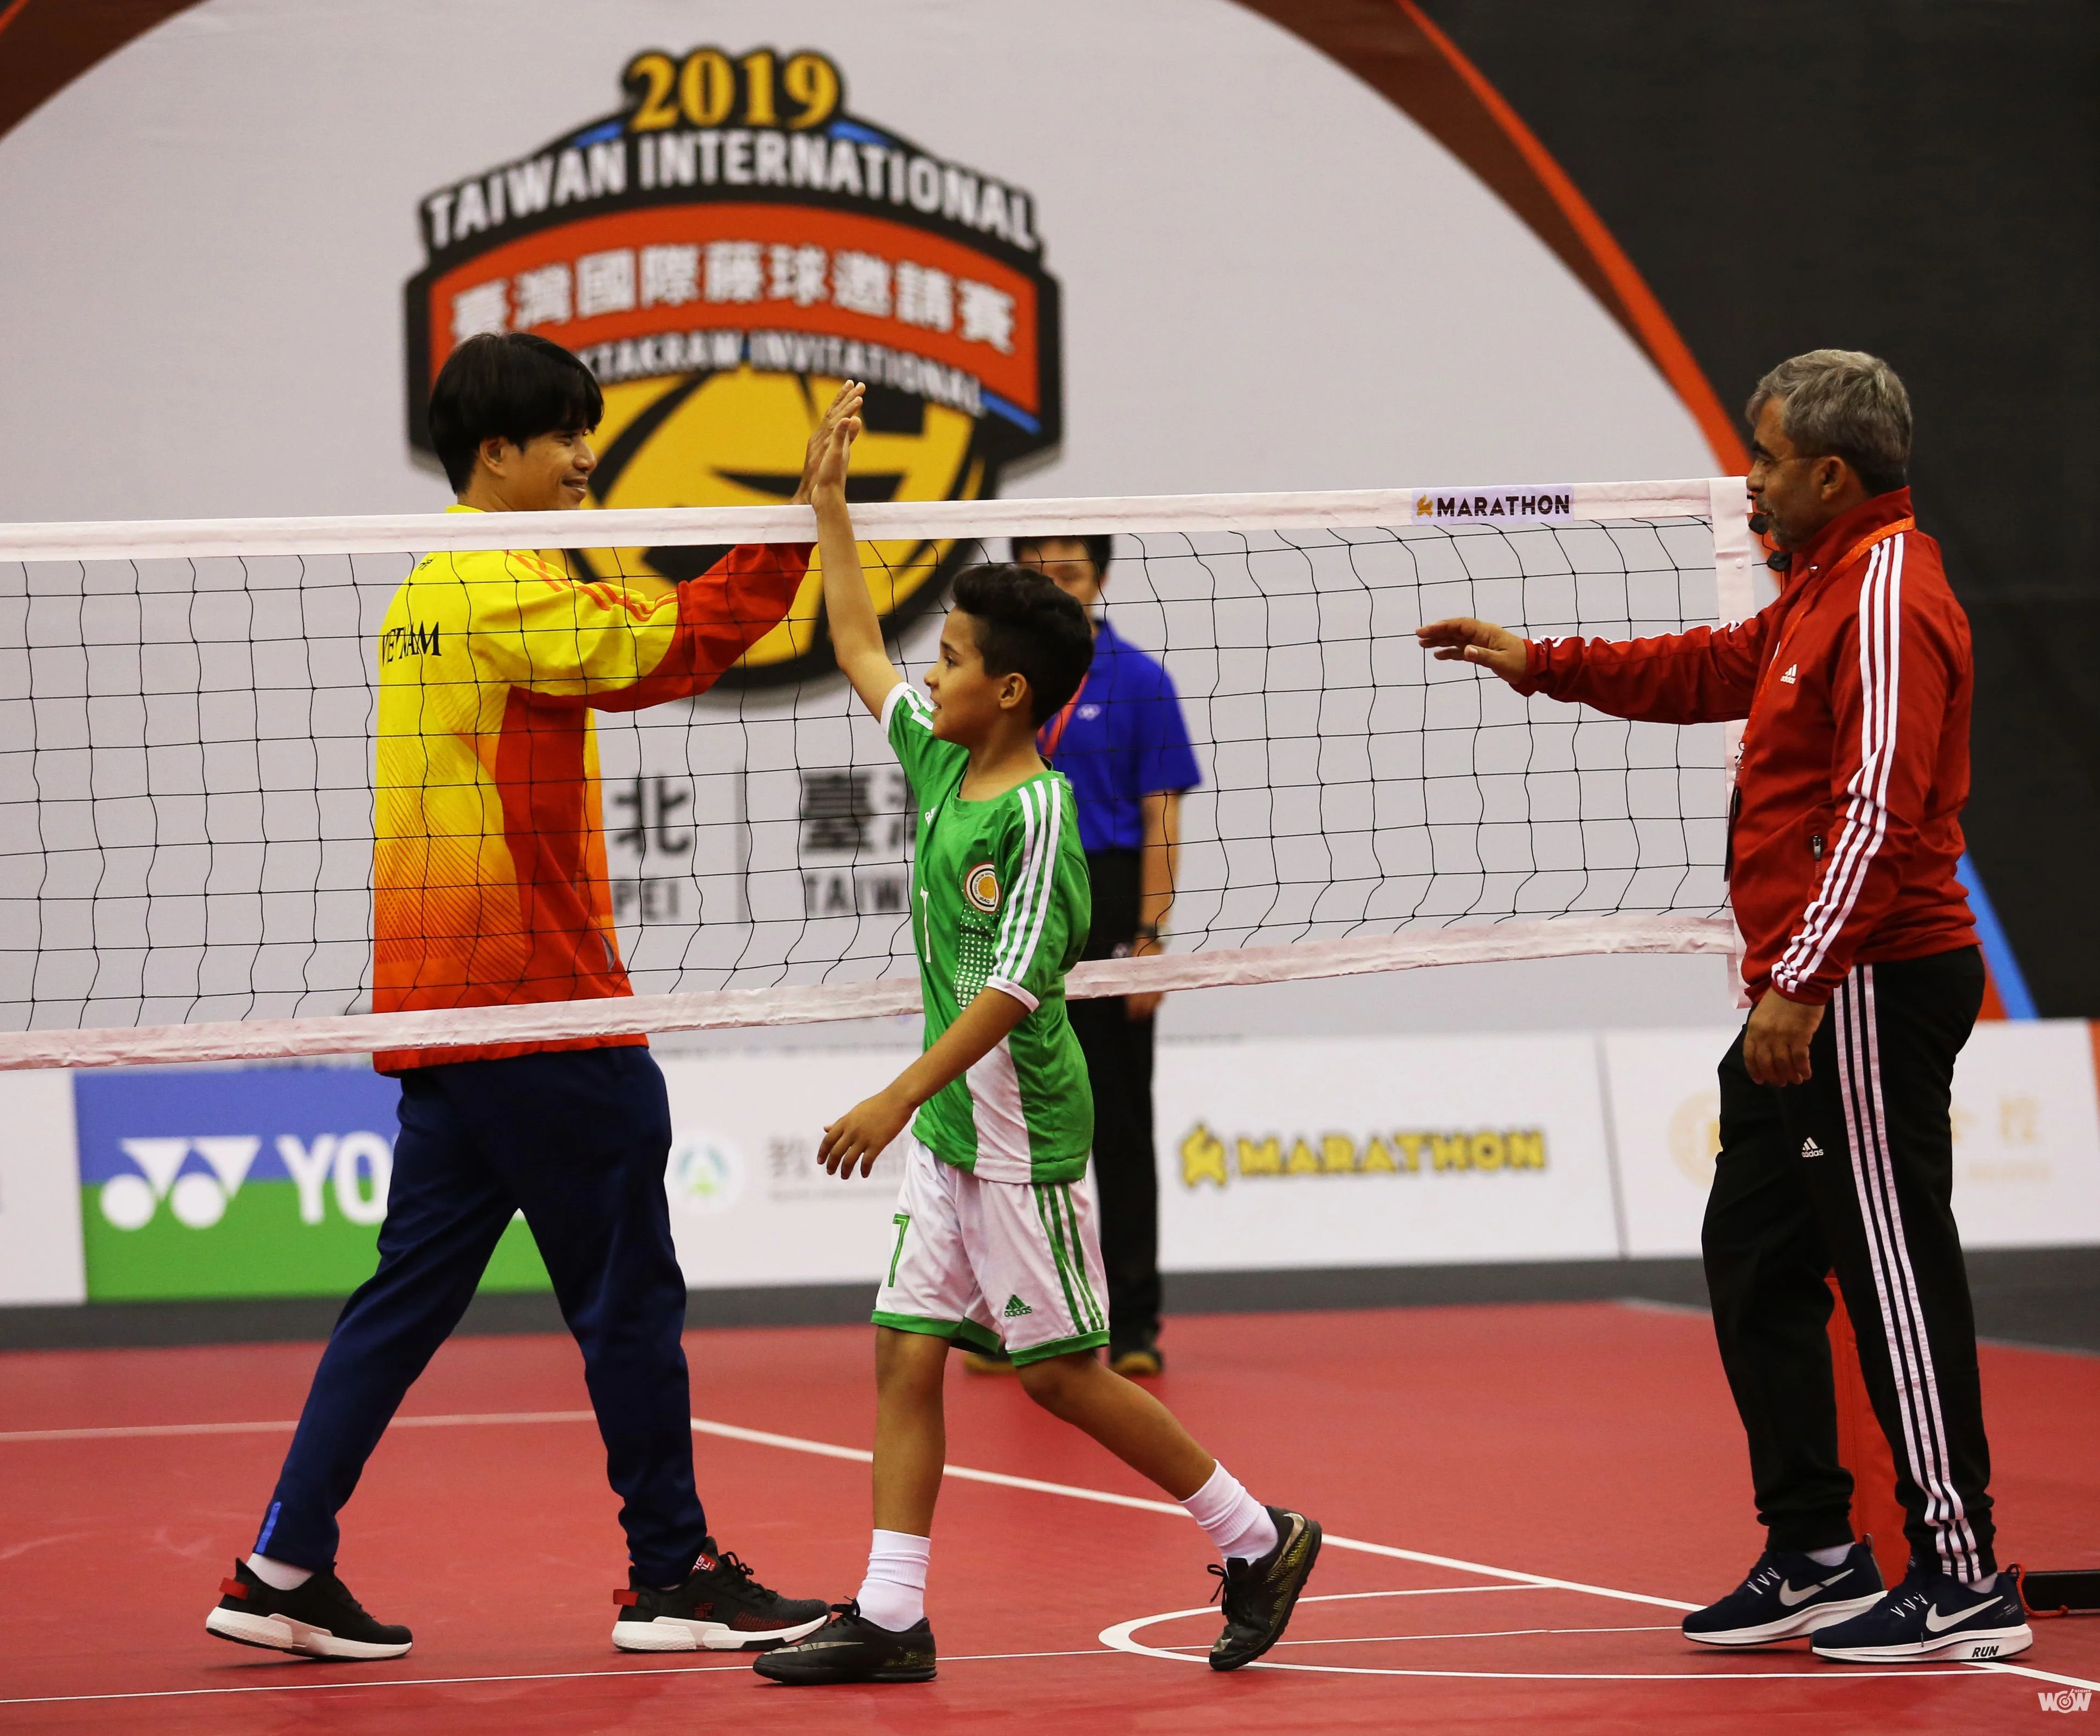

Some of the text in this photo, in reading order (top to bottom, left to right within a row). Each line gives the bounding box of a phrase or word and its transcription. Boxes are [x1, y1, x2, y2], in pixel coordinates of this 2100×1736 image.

[628, 49, 840, 132] 2019
[430, 128, 1040, 251] TAIWAN INTERNATIONAL
[748, 328, 987, 416] INVITATIONAL
[1437, 494, 1570, 517] MARATHON
[274, 1130, 396, 1227] YO
[1236, 1128, 1548, 1177] MARATHON
[892, 1213, 910, 1288] 7
[1004, 1306, 1033, 1317] adidas
[1972, 1645, 2000, 1658] RUN
